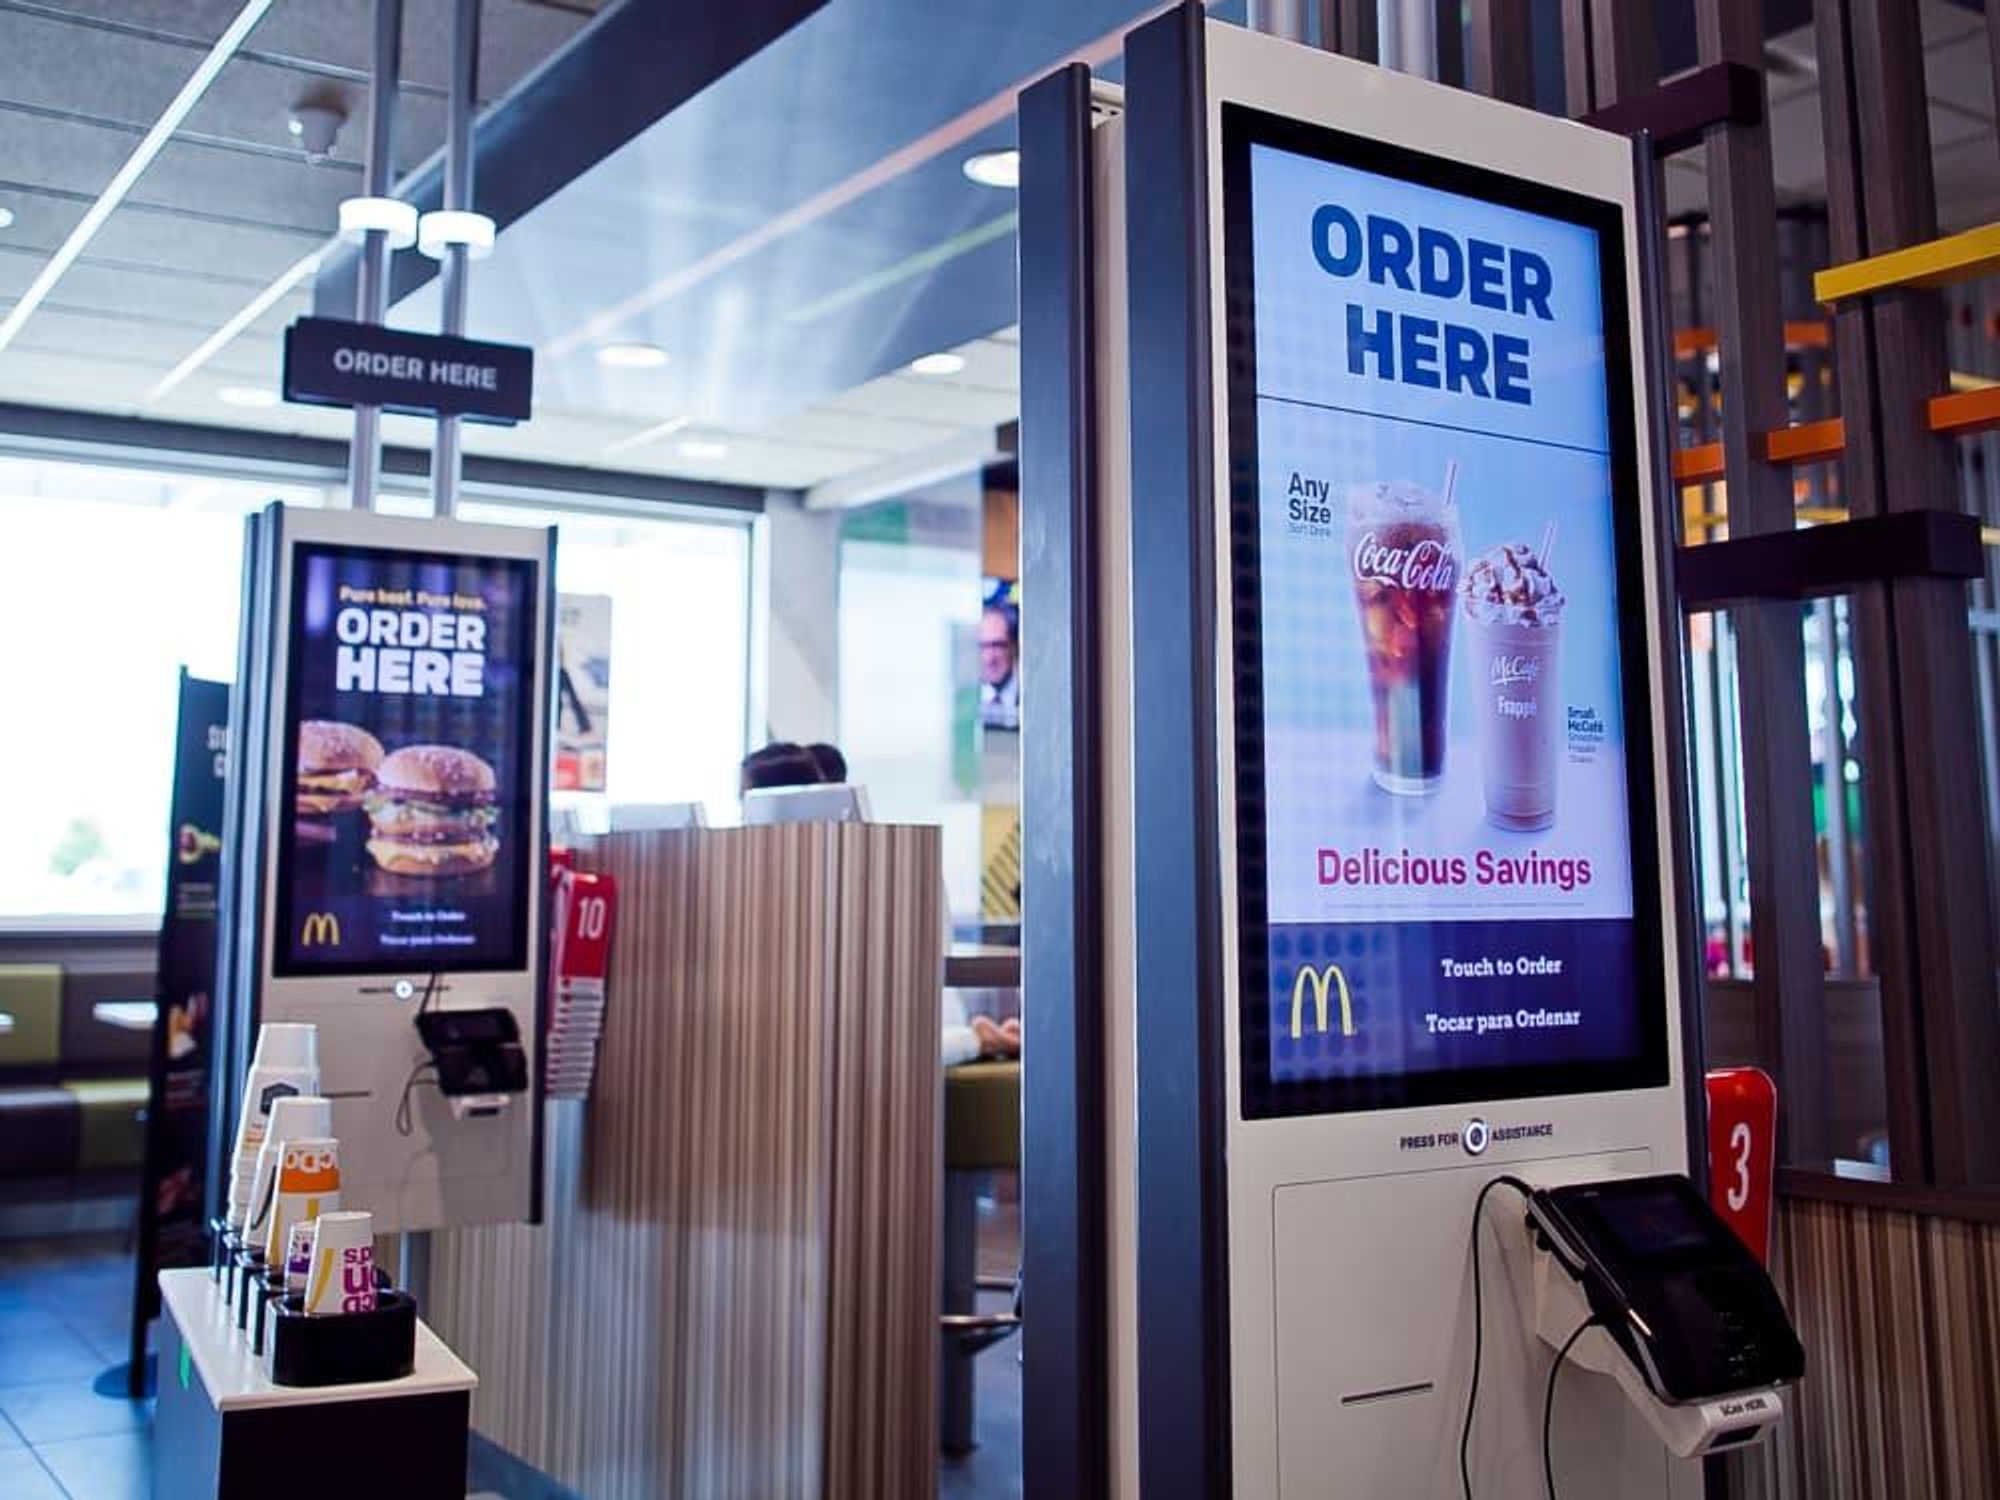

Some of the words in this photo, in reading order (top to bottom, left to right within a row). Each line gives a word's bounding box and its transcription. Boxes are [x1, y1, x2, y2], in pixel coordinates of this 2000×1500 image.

[1312, 204, 1554, 321] ORDER
[333, 347, 424, 381] ORDER
[429, 360, 497, 391] HERE
[1346, 304, 1532, 405] HERE
[1288, 472, 1329, 504] Any
[1289, 498, 1331, 524] Size
[1353, 532, 1453, 590] Coca-Cola
[336, 608, 486, 651] ORDER
[335, 645, 485, 697] HERE
[1318, 848, 1467, 886] Delicious
[1476, 849, 1592, 892] Savings
[578, 896, 605, 940] 10
[1442, 957, 1495, 978] Touch
[1497, 958, 1514, 976] to
[1516, 956, 1562, 975] Order
[1425, 1013, 1475, 1033] Tocar
[1477, 1013, 1513, 1035] para
[1515, 1009, 1581, 1029] Ordenar
[1400, 1135, 1435, 1150] PRESS
[1438, 1132, 1459, 1147] FOR
[1492, 1123, 1553, 1141] ASSISTANCE
[1728, 1122, 1753, 1213] 3
